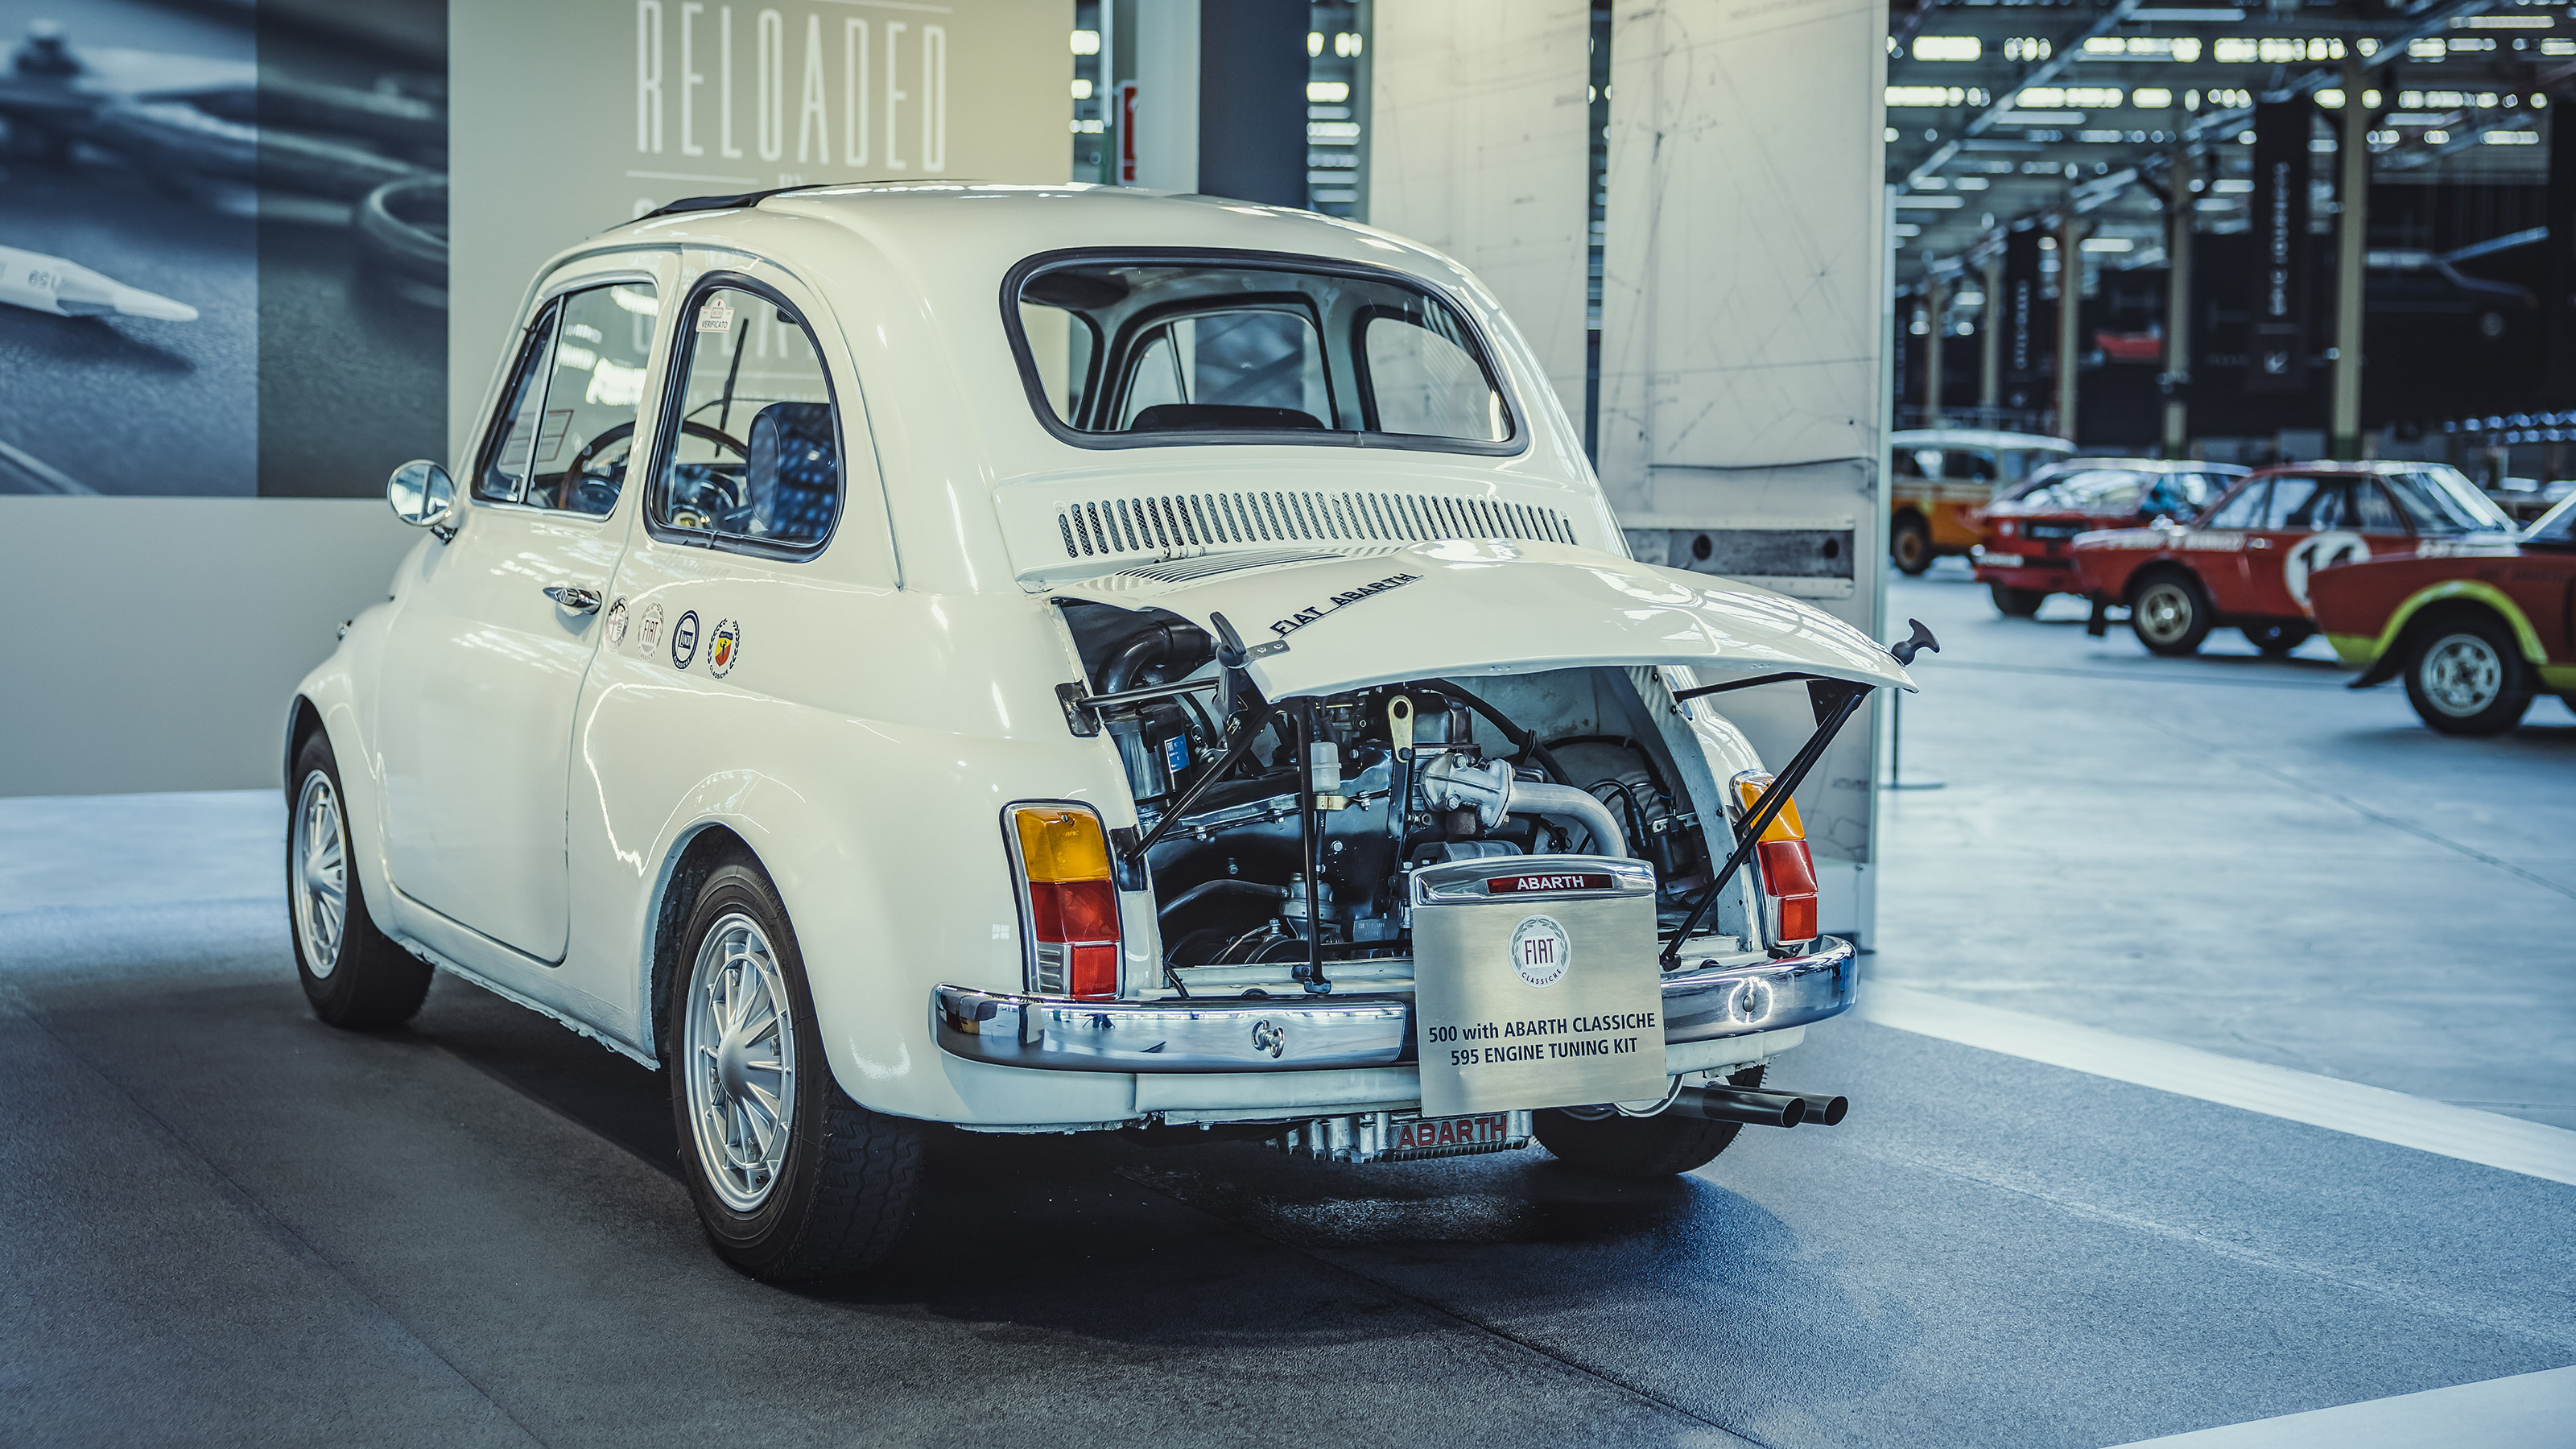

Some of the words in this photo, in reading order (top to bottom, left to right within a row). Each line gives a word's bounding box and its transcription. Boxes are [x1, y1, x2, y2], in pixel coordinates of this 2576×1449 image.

[638, 0, 946, 172] RELOADED
[702, 320, 728, 329] VERIFICATO
[1269, 606, 1324, 636] FIAT
[1330, 572, 1418, 606] ABARTH
[642, 619, 658, 644] FIAT
[1517, 876, 1584, 890] ABARTH
[1524, 938, 1554, 965] FIAT
[1521, 968, 1562, 985] CLASSICHE
[1429, 1026, 1458, 1043] 500
[1462, 1022, 1499, 1041] with
[1504, 1018, 1567, 1038] ABARTH
[1572, 1012, 1656, 1033] CLASSICHE
[1451, 1048, 1479, 1067] 595
[1485, 1044, 1545, 1063] ENGINE
[1549, 1039, 1608, 1059] TUNING
[1613, 1037, 1638, 1054] KIT
[1397, 1117, 1507, 1150] ABARTH
